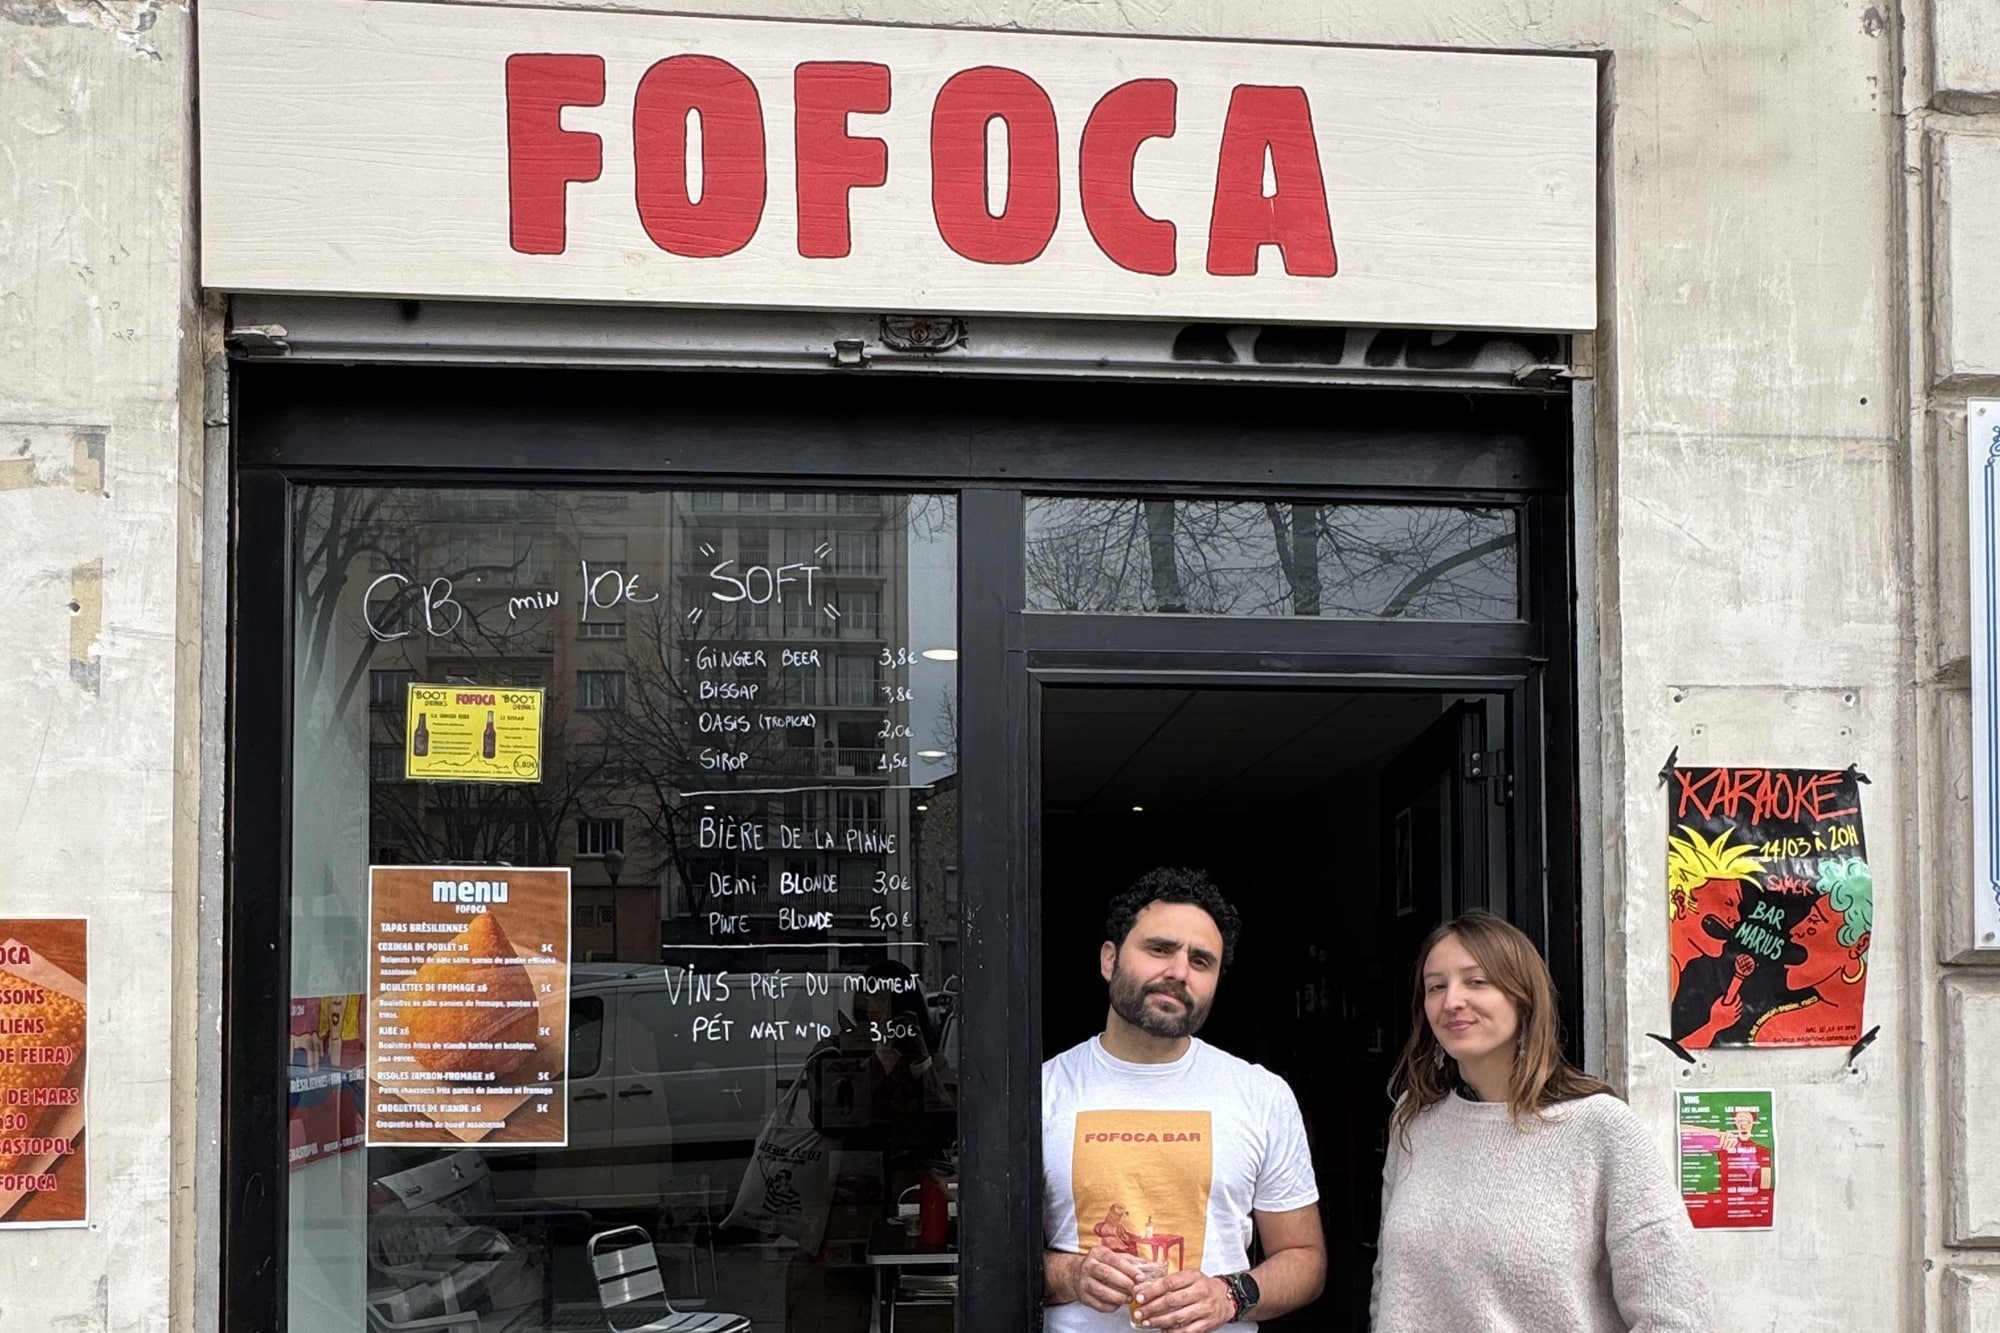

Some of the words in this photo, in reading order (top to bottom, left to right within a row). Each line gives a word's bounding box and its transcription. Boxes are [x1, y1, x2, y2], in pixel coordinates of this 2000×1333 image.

[504, 52, 1338, 277] FOFOCA
[710, 559, 821, 606] SOFT
[364, 573, 462, 641] CB
[580, 560, 659, 621] 10€
[781, 649, 821, 668] BEER
[878, 647, 918, 669] 3,8€
[455, 694, 496, 705] FOFOCA
[880, 687, 914, 703] 3,8€
[877, 720, 914, 739] 2,0€
[877, 753, 909, 773] 1,5€
[1673, 767, 1858, 826] KARAOKE
[780, 824, 801, 850] DE
[815, 828, 835, 850] LA
[1760, 837, 1811, 863] 14/03
[1828, 824, 1860, 851] 20H
[432, 879, 509, 903] menu
[780, 871, 838, 895] BLONDE
[872, 870, 911, 895] 3,0€
[1766, 874, 1814, 896] SNACK
[455, 904, 487, 914] FOFOCA
[1748, 900, 1785, 930] BAR
[778, 908, 834, 930] BLONDE
[869, 906, 912, 930] 5,0€
[380, 922, 408, 933] TAPAS
[414, 942, 426, 952] DE
[426, 942, 457, 952] POULET
[541, 943, 554, 953] 5€
[379, 983, 424, 992] BOULETTES
[424, 983, 436, 992] DE
[437, 983, 476, 992] FROMAGE
[477, 983, 488, 993] x6
[540, 983, 552, 993] 5€
[806, 973, 829, 996] DU
[0, 989, 45, 1005] SONS
[539, 1026, 551, 1036] 5€
[692, 1013, 735, 1042] PÉT
[750, 1021, 790, 1040] NAT
[868, 1020, 917, 1044] 3,50€
[20, 1048, 73, 1064] FEIRA)
[377, 1071, 409, 1080] RISOLES
[411, 1071, 484, 1080] JAMBON-FROMAGE
[484, 1071, 496, 1080] x6
[537, 1071, 550, 1080] 5€
[8, 1090, 29, 1105] DE
[34, 1088, 79, 1105] MARS
[377, 1103, 426, 1113] CROQUETTES
[427, 1103, 438, 1113] DE
[439, 1103, 470, 1113] VIANDE
[470, 1104, 482, 1113] x6
[536, 1103, 549, 1113] 5€
[1084, 1132, 1159, 1143] FOFOCA
[1162, 1132, 1201, 1143] BAR
